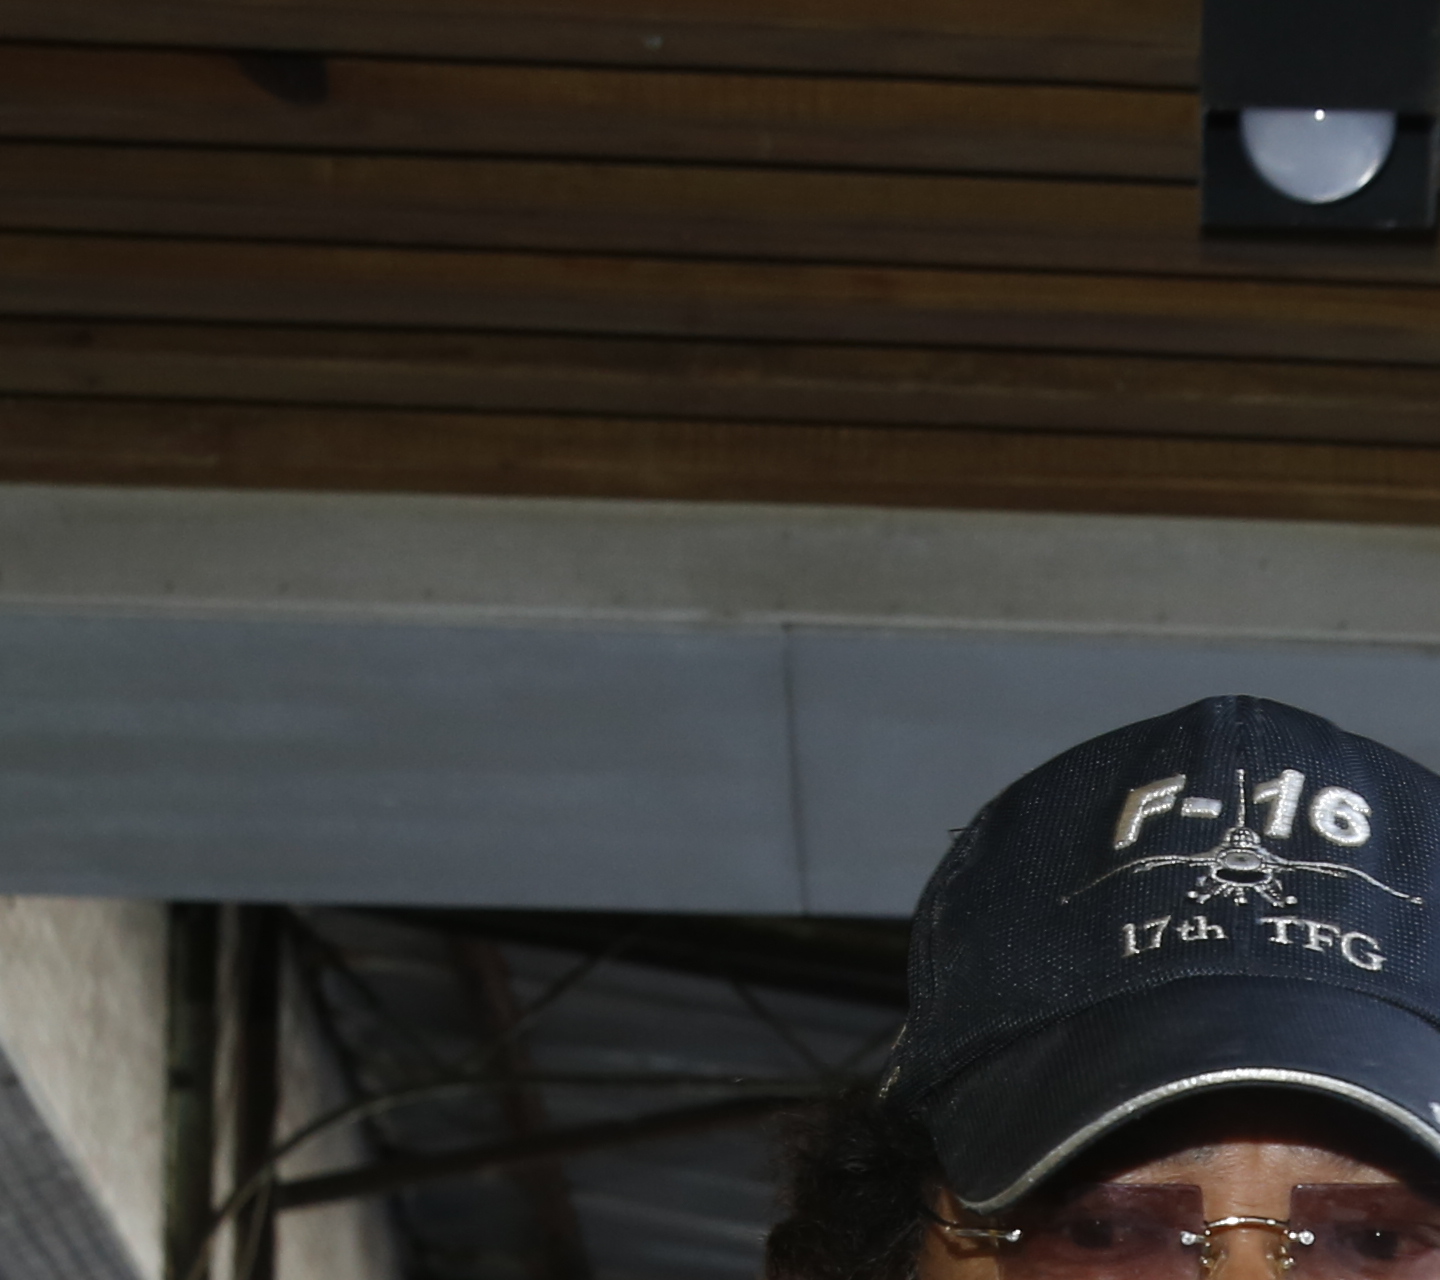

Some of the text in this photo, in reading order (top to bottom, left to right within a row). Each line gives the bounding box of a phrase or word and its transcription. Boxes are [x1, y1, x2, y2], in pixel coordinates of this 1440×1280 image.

[1113, 768, 1372, 849] F-16
[1120, 914, 1387, 972] 17th TFG
